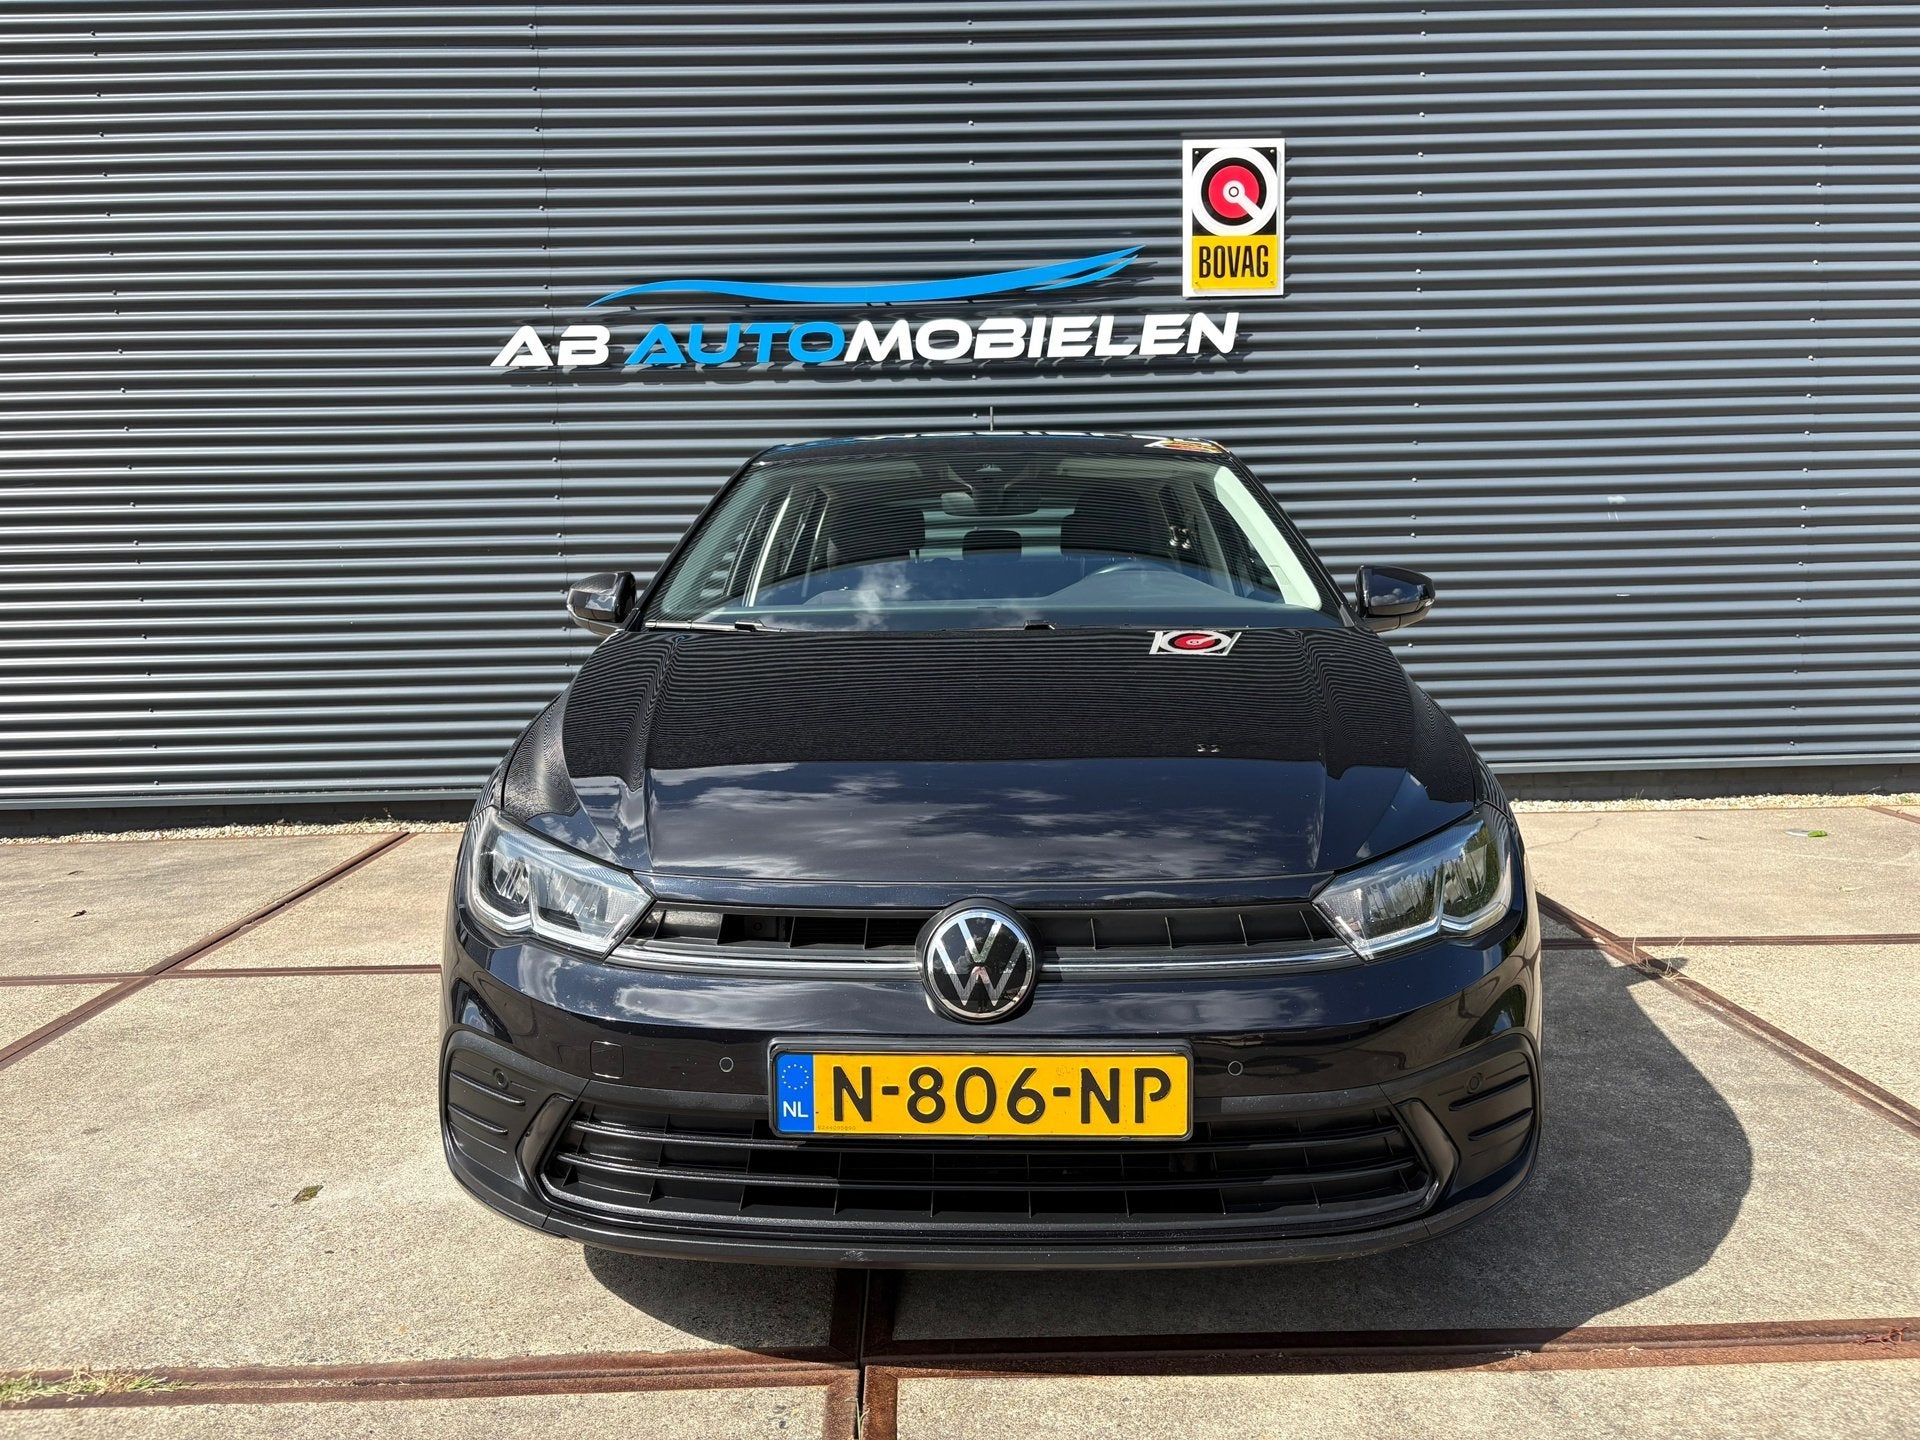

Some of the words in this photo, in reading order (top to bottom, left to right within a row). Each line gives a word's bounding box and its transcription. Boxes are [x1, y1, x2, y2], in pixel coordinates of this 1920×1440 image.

[1199, 244, 1269, 278] BOVAG
[489, 324, 611, 367] AB
[624, 311, 1240, 368] AUTOMOBIELEN
[783, 1101, 809, 1118] NL
[832, 1066, 1172, 1124] N-806-NP
